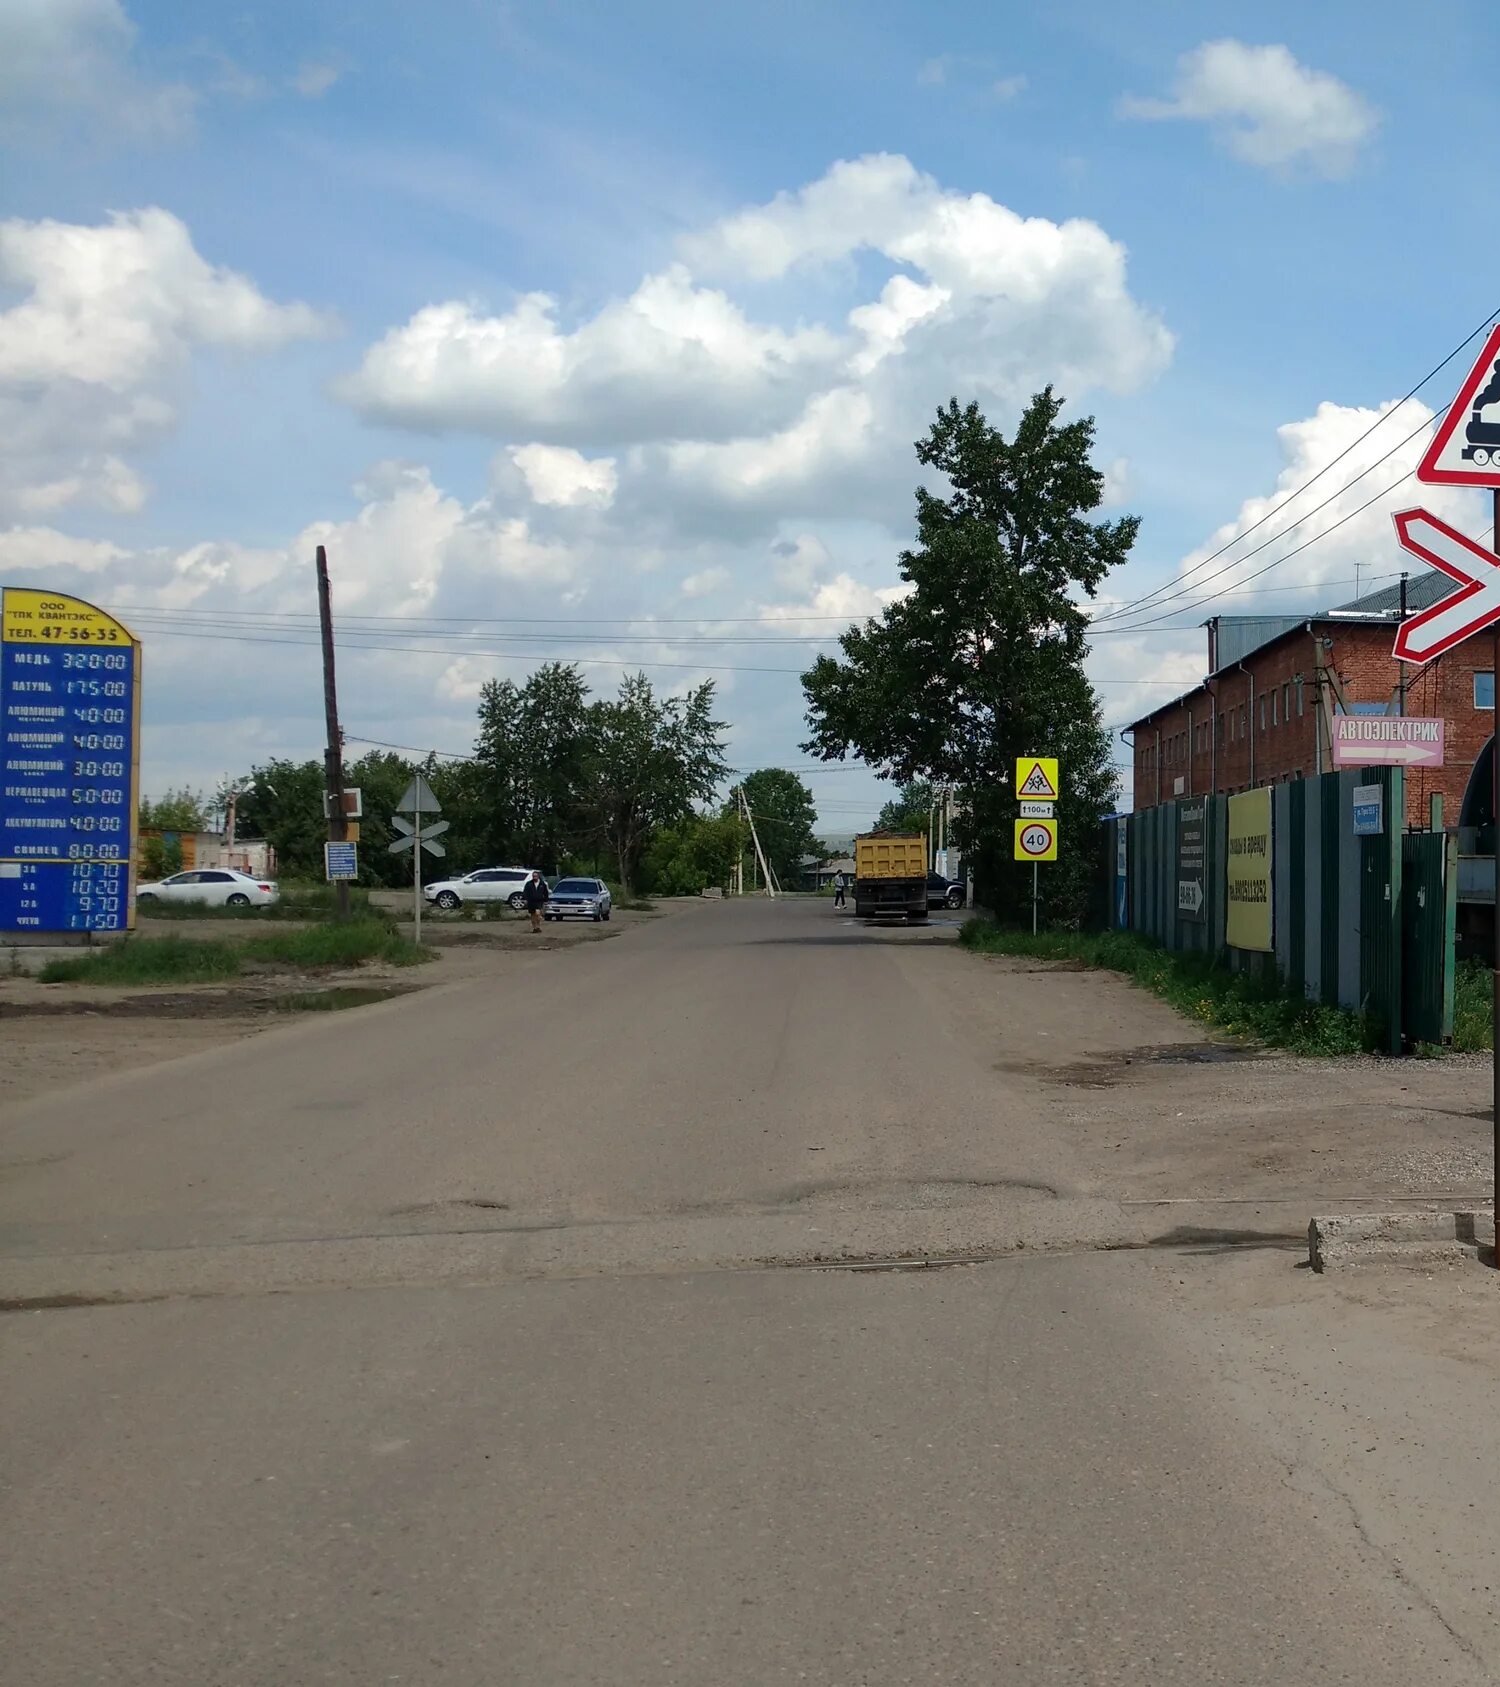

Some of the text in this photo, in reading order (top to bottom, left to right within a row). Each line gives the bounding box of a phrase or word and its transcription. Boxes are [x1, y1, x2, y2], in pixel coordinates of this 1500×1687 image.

[40, 602, 65, 610] ООО
[8, 627, 117, 640] ТЕЛ. 47-56-35
[15, 654, 51, 664] МЕДЬ
[12, 681, 52, 691] ЛАТУНЬ
[8, 706, 64, 716] АЛЮМИНИЙ
[1339, 720, 1439, 741] АВТОЭЛЕКТРИК
[8, 732, 64, 742] АЛЮМИНИЙ
[7, 760, 64, 770] АЛЮМИНИЙ
[1027, 835, 1044, 845] 40
[14, 846, 58, 855] СВИНЕЦ
